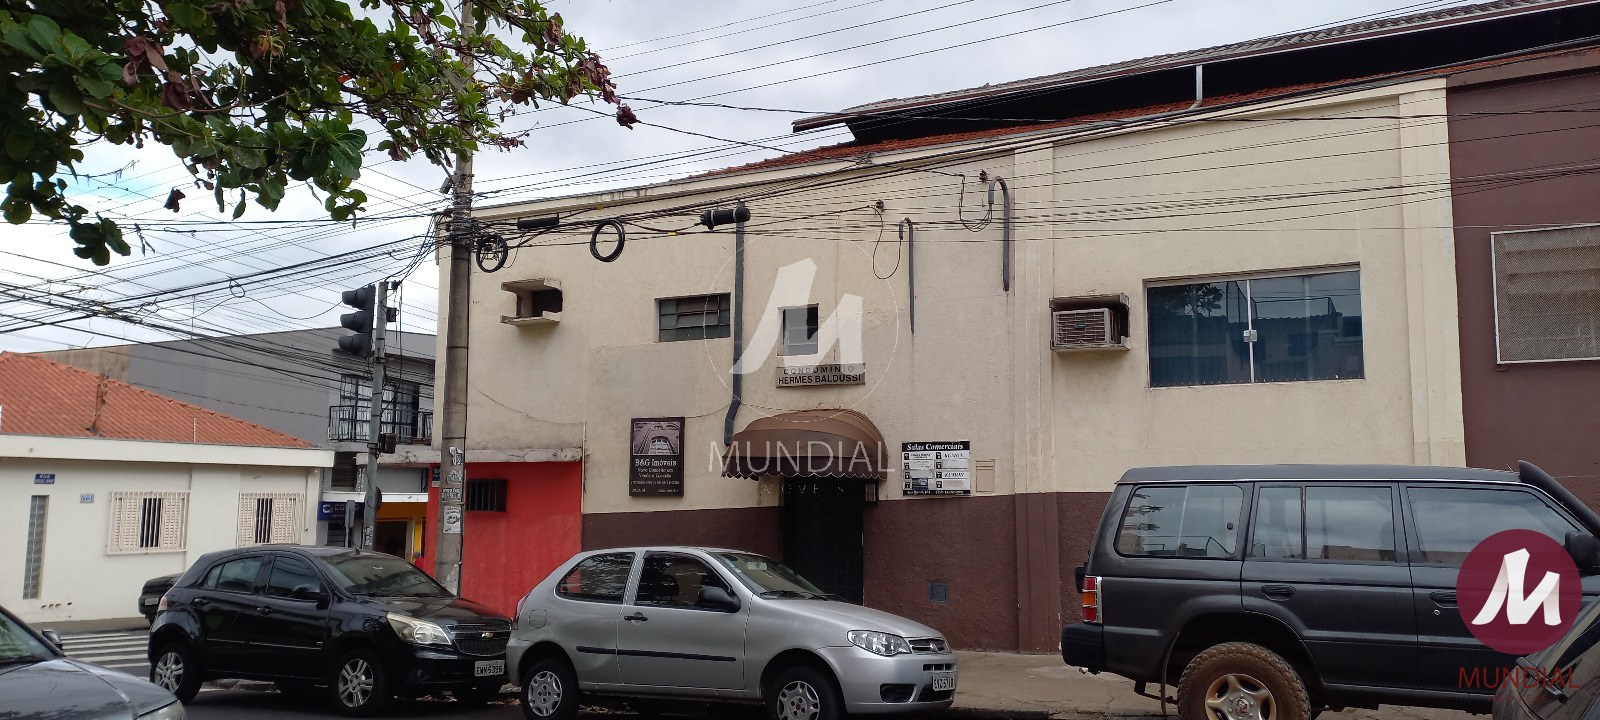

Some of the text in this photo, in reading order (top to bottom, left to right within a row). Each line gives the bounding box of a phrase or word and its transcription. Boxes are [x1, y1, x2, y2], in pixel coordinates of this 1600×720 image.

[778, 374, 861, 385] HERMES BALDUSSI
[634, 458, 677, 467] B&G Imóveis
